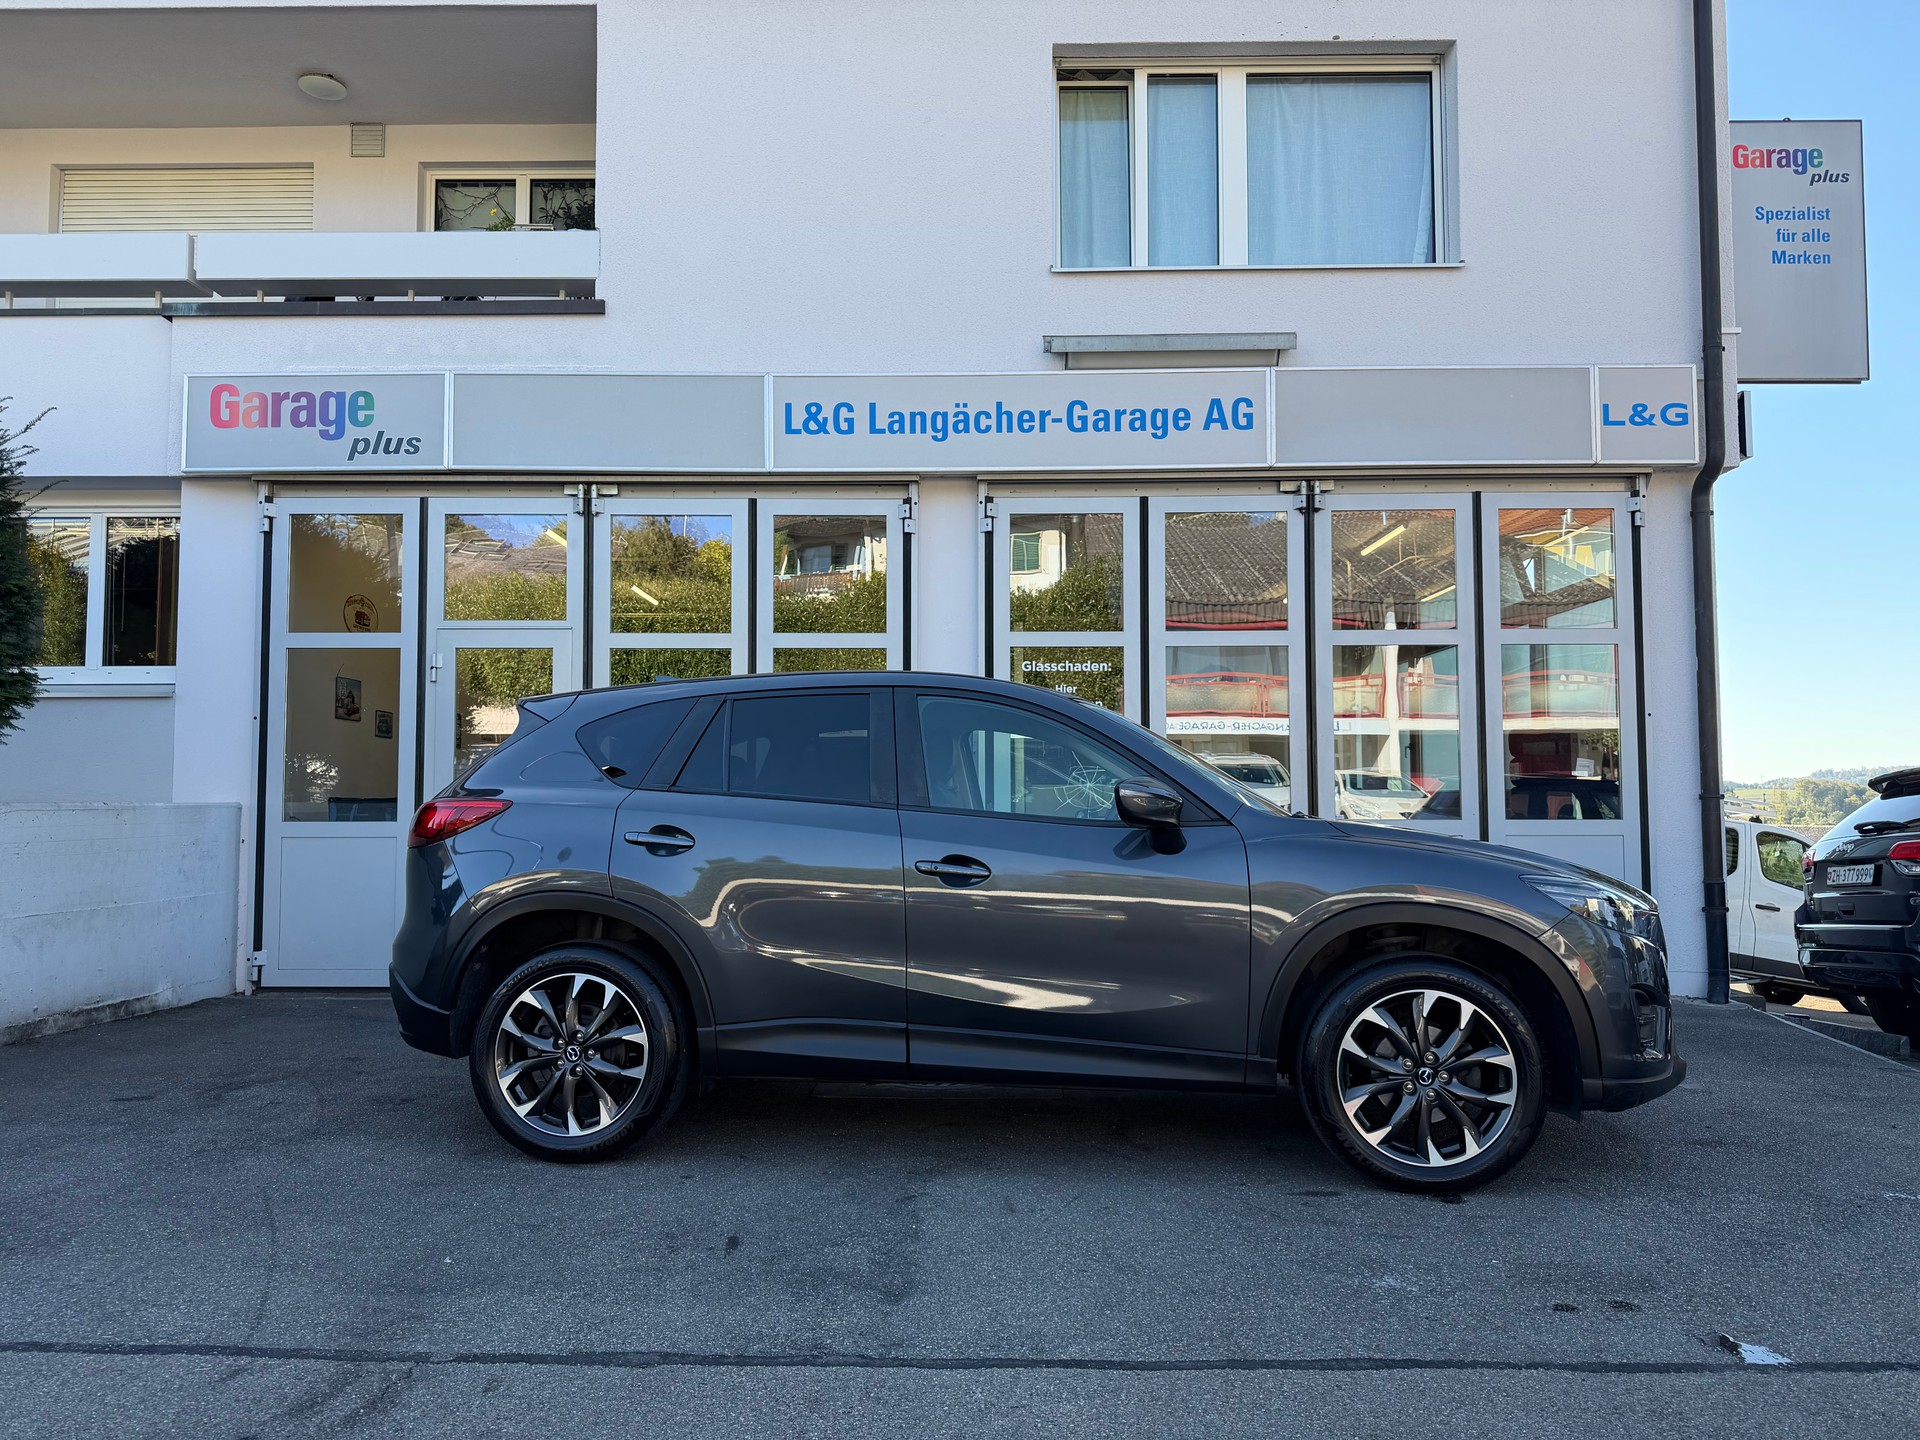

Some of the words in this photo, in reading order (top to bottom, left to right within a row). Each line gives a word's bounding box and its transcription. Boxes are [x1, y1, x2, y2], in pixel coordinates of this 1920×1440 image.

[1732, 144, 1824, 175] Garage
[1809, 169, 1850, 186] plus
[1754, 205, 1831, 224] Spezialist
[1775, 228, 1797, 243] für
[1801, 228, 1831, 243] alle
[1771, 250, 1831, 265] Marken
[209, 383, 376, 441] Garage
[784, 401, 855, 436] L&G
[868, 399, 1192, 443] Langächer-Garage
[1203, 397, 1255, 432] AG
[1602, 402, 1690, 427] L&G
[346, 430, 422, 462] plus
[1021, 661, 1112, 672] Glasschaden:
[1055, 685, 1078, 693] Hier
